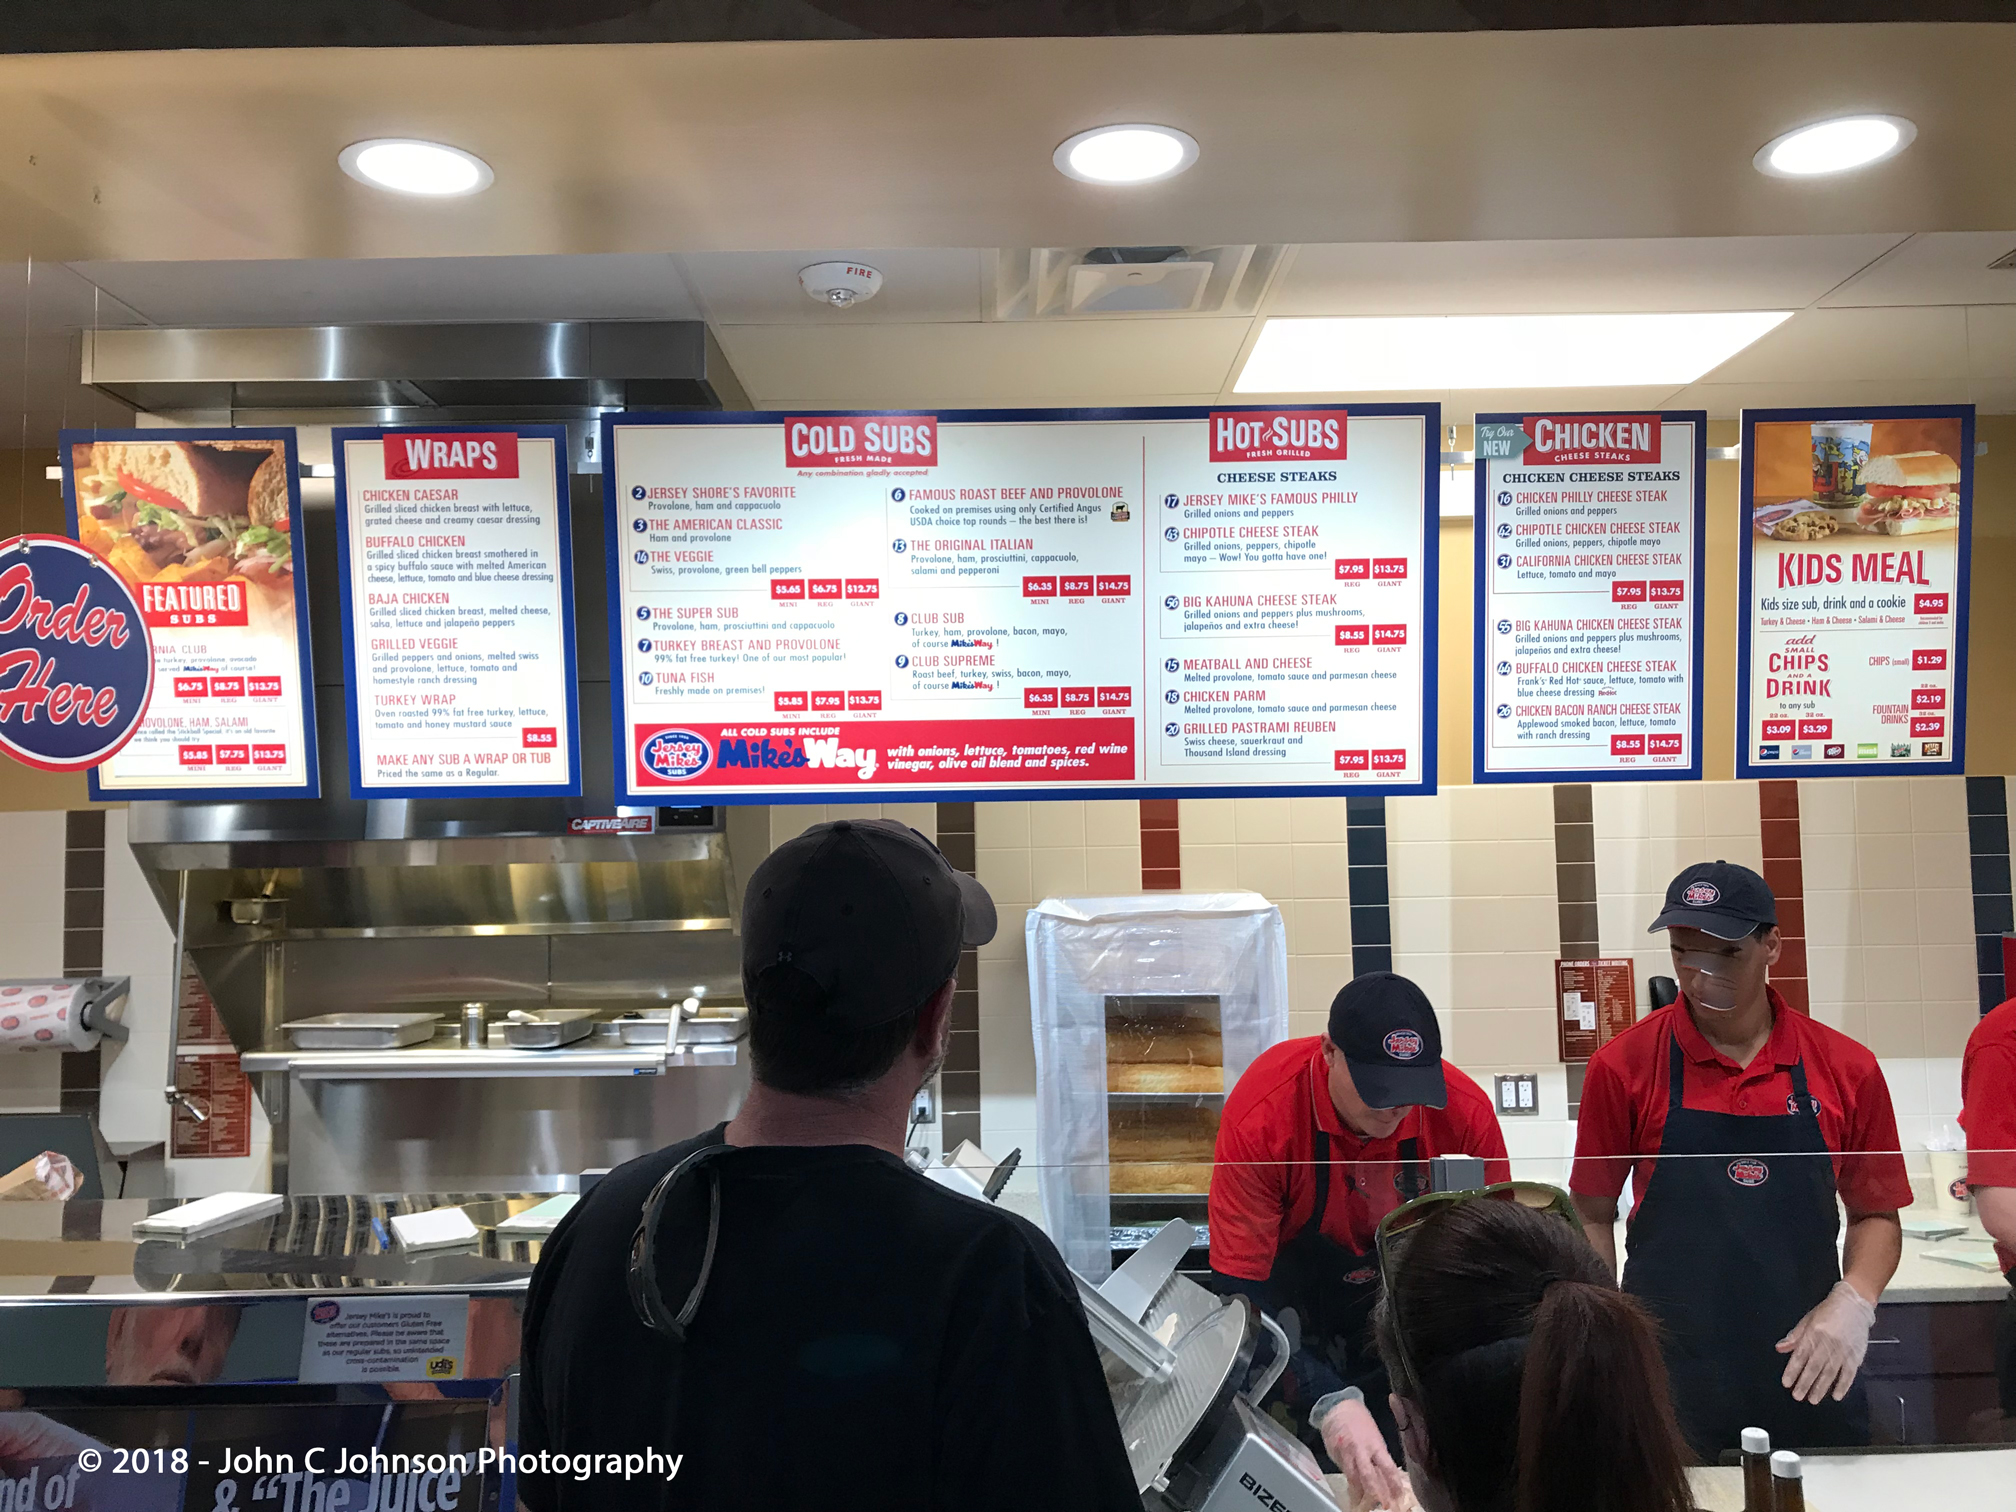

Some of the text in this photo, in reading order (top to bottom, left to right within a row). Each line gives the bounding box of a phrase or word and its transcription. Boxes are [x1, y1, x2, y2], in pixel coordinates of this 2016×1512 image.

[846, 267, 872, 278] FIRE
[1217, 417, 1339, 452] HOT SUBS
[1481, 426, 1514, 438] Try Our
[1535, 419, 1650, 453] CHICKEN
[792, 422, 931, 457] COLD SUBS
[406, 439, 498, 470] WRAPS
[1247, 449, 1311, 458] FRESH GRILLED
[1484, 441, 1511, 456] NEW
[1555, 452, 1630, 462] CHEESE STEAKS
[893, 469, 928, 477] accepted
[1217, 471, 1337, 483] CHEESE STEAKS
[1503, 471, 1680, 483] CHICKEN CHEESE STEAKS
[363, 489, 458, 501] CHICKEN CAESAR
[648, 487, 796, 499] JERSEY SHORE'S FAVORITE
[909, 487, 1123, 500] FAMOUS ROAST BEEF AND PROVOLONE
[1183, 492, 1358, 506] JERSEY MIKE'S FAMOUS PHILLY
[1516, 490, 1667, 503] CHICKEN PHILLY CHEESE STEAK
[365, 503, 532, 513] Grilled sliced chicken breast with lettuce,
[649, 501, 781, 511] Provolone, ham and cappacuolo
[649, 519, 782, 531] THE AMERICAN CLASSIC
[1183, 526, 1319, 539] CHIPOTLE CHEESE STEAK
[366, 536, 465, 548] BUFFALO CHICKEN
[1339, 564, 1404, 574] $7.95 $13.75
[1778, 550, 1929, 589] KIDS MEAL
[776, 584, 877, 594] $5.65 $6.75 $12.75
[1028, 581, 1128, 591] $6.35 $8.75 $14.75
[1617, 586, 1680, 597] $7.95 $13.75
[143, 584, 239, 612] FEATURED
[369, 592, 449, 604] BAJA CHICKEN
[1761, 595, 1905, 612] Kids size sub, drink and a cookie
[1919, 599, 1943, 609] $4.95
[0, 563, 129, 649] Order
[170, 614, 216, 624] SUBS
[654, 639, 841, 651] TURKEY BREAST AND PROVOLONE
[912, 655, 995, 667] CLUB SUPREME
[1769, 653, 1829, 673] CHIPS
[1918, 656, 1942, 665] $1.29
[0, 648, 118, 727] Here
[178, 681, 279, 691] $6.75 $8.75 $13.75
[1767, 678, 1831, 698] DRINK
[375, 694, 456, 706] TURKEY WRAP
[1916, 695, 1941, 704] $2.19
[741, 728, 767, 736] COLD
[770, 728, 795, 736] SUBS
[799, 727, 840, 735] INCLUDE
[1767, 725, 1827, 734] $3.09 $3.29
[1915, 723, 1940, 732] $2.39
[527, 733, 552, 743] $8.55
[650, 739, 702, 756] Jersey
[887, 743, 1127, 757] with onions, lettuce, tomatoes, red wine
[183, 749, 284, 760] $5.85 $7.75 $13.75
[377, 753, 551, 766] MAKE ANY SUB A WRAP OR TUB
[888, 756, 1089, 772] vinegar, olive oil blend and spices.
[572, 818, 648, 830] CAPTIVEAIRE
